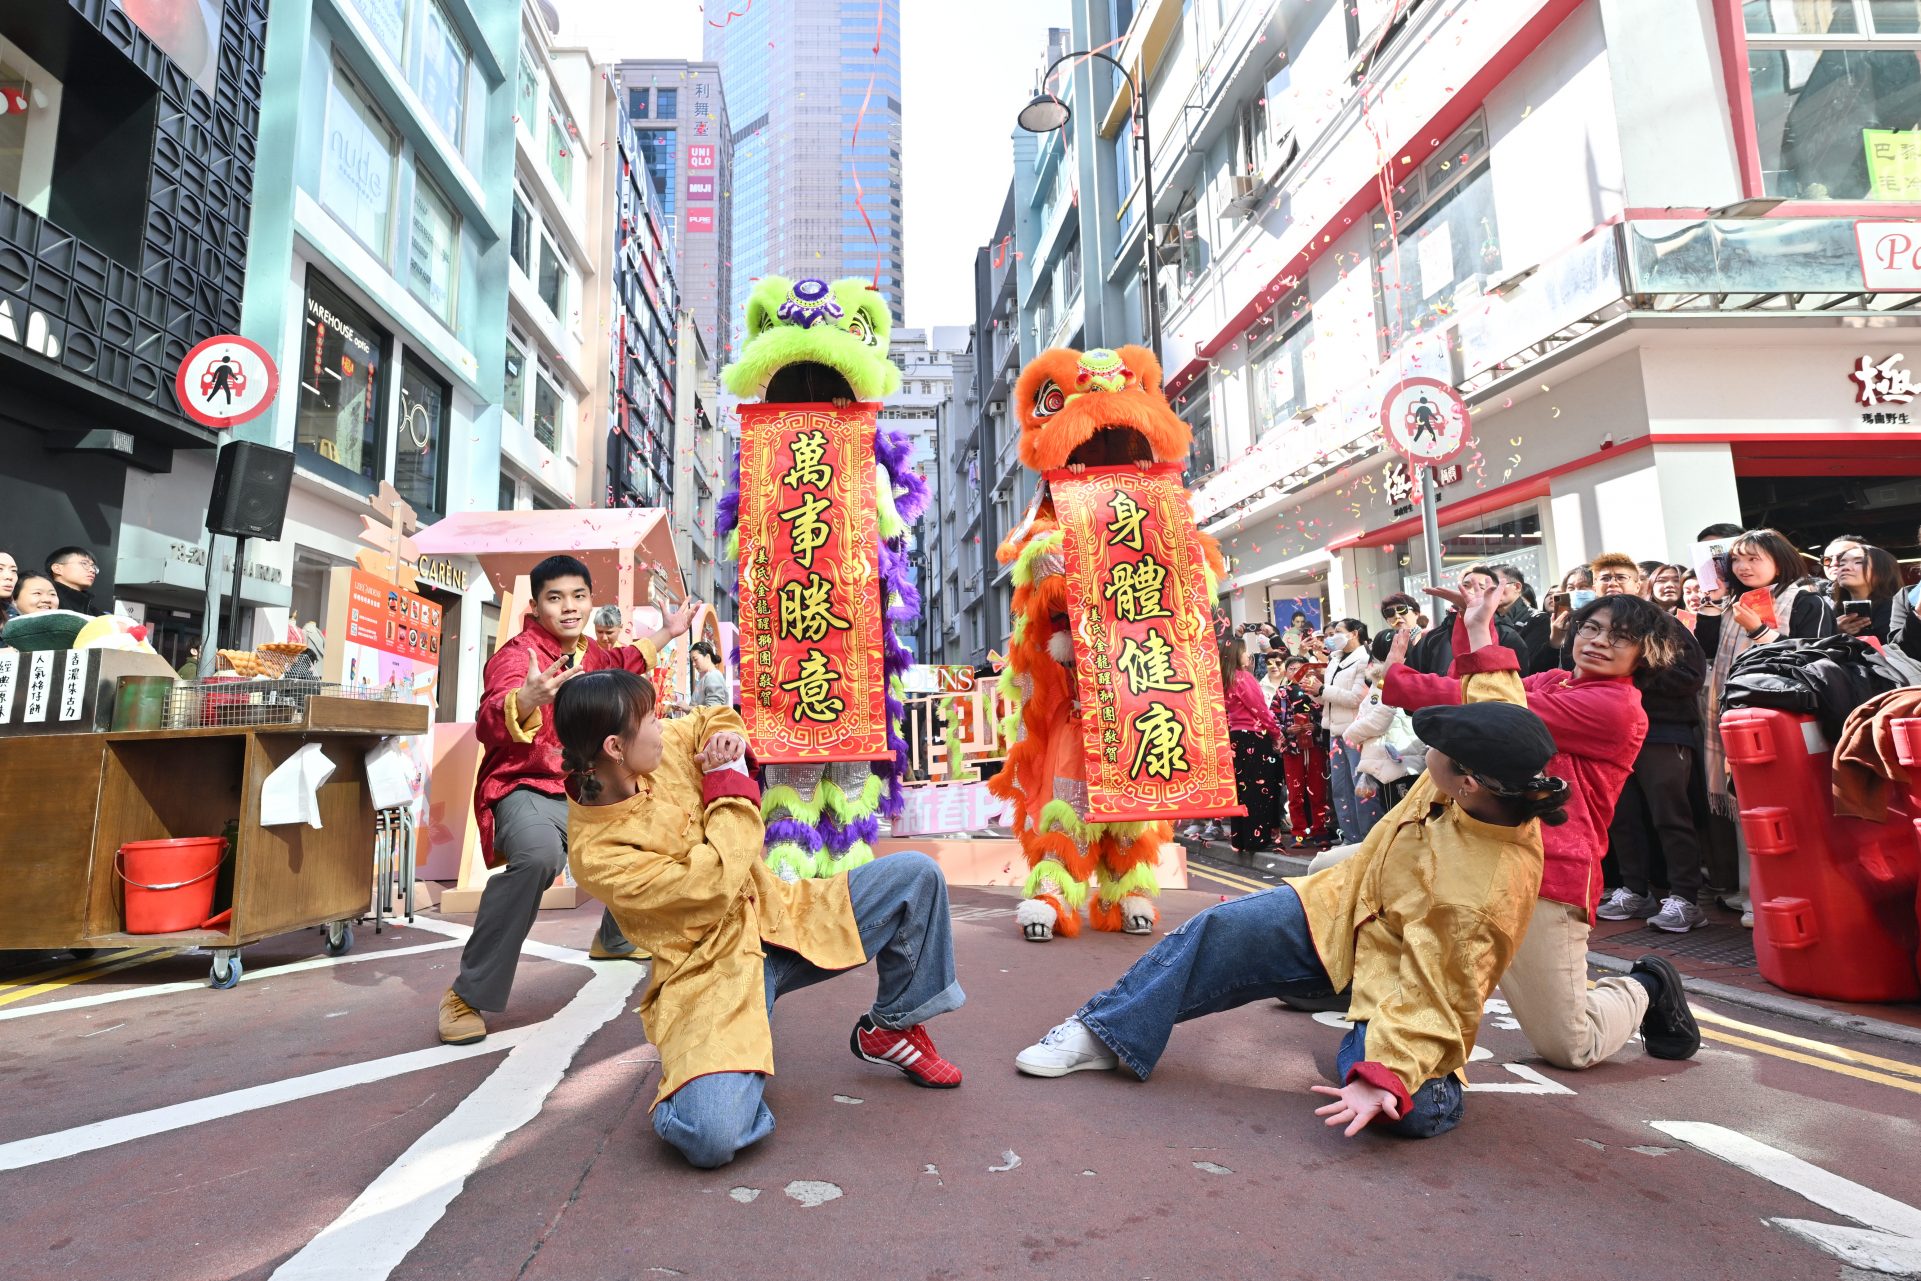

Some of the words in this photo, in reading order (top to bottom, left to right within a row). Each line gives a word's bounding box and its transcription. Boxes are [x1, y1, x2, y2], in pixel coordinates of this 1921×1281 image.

[331, 130, 382, 198] nude
[691, 147, 710, 157] UNI
[691, 157, 711, 167] QLO
[689, 183, 712, 193] MUJI
[354, 337, 370, 354] optic
[1861, 412, 1911, 425] 瑪曲野生
[418, 555, 467, 591] CARÈNE
[777, 429, 853, 723] 萬事勝意
[755, 547, 773, 667] 姜氏金龍醒獅團
[1105, 489, 1193, 780] 身體健康
[29, 655, 46, 715] 人氣格仔餅
[65, 652, 80, 717] 香濃朱古力
[758, 672, 775, 707] 敬賀
[1089, 606, 1117, 723] 姜氏金龍醒獅團
[1103, 729, 1121, 763] 敬賀
